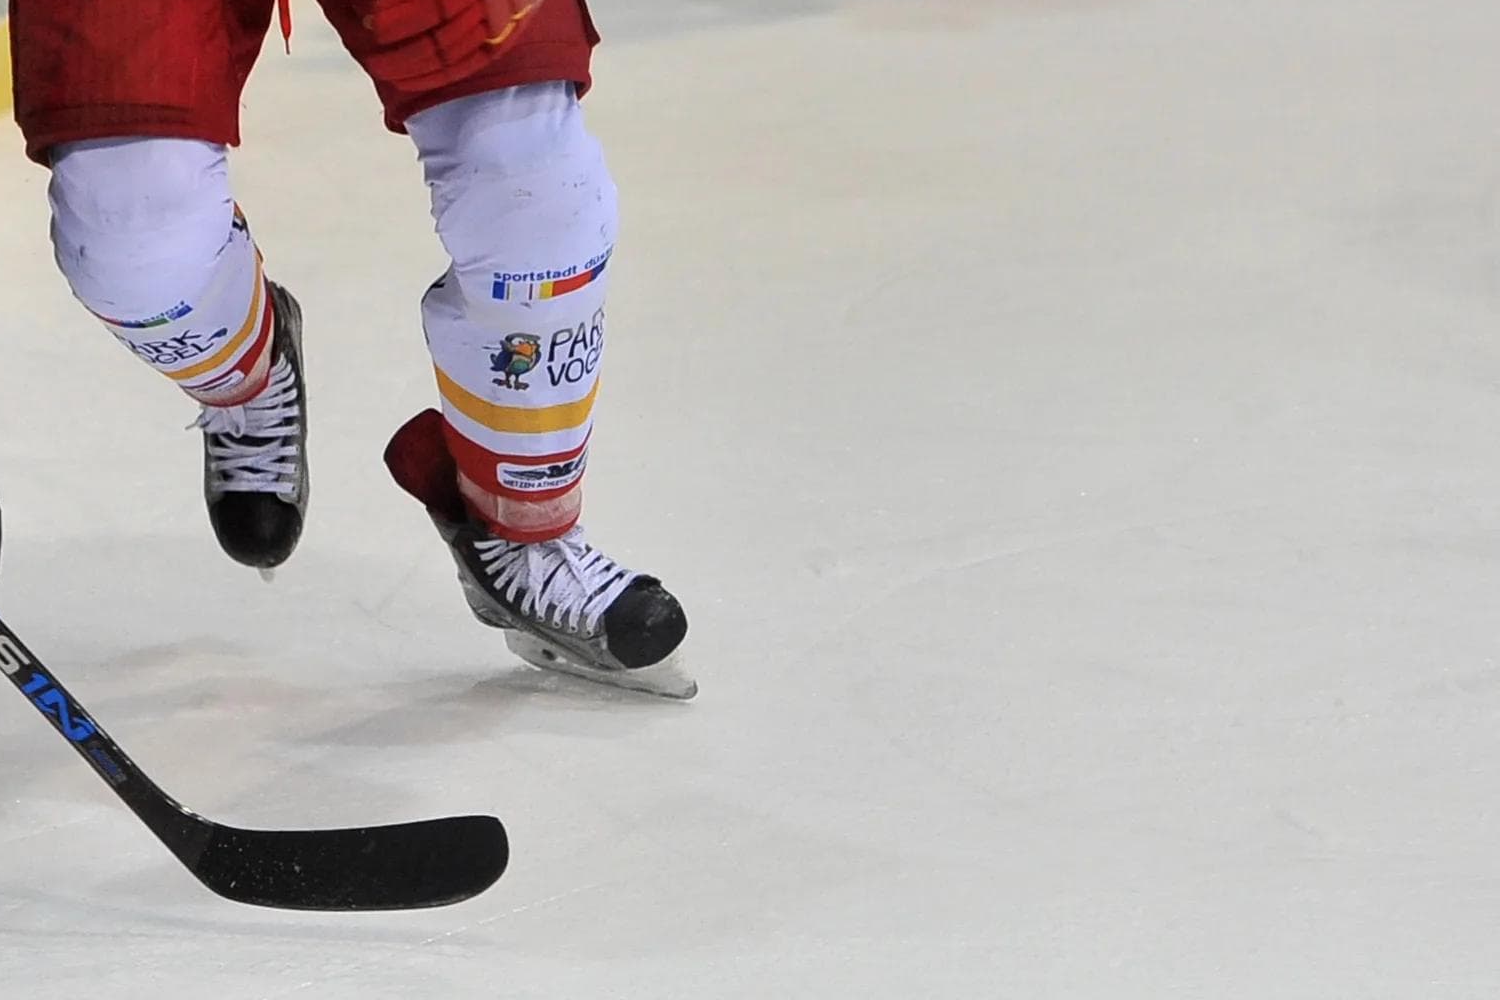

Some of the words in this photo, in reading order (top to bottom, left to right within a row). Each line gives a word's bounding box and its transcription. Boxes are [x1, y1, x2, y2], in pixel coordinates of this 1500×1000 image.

[493, 264, 578, 283] sportstadt
[547, 307, 605, 362] PAR
[547, 350, 603, 387] VOG
